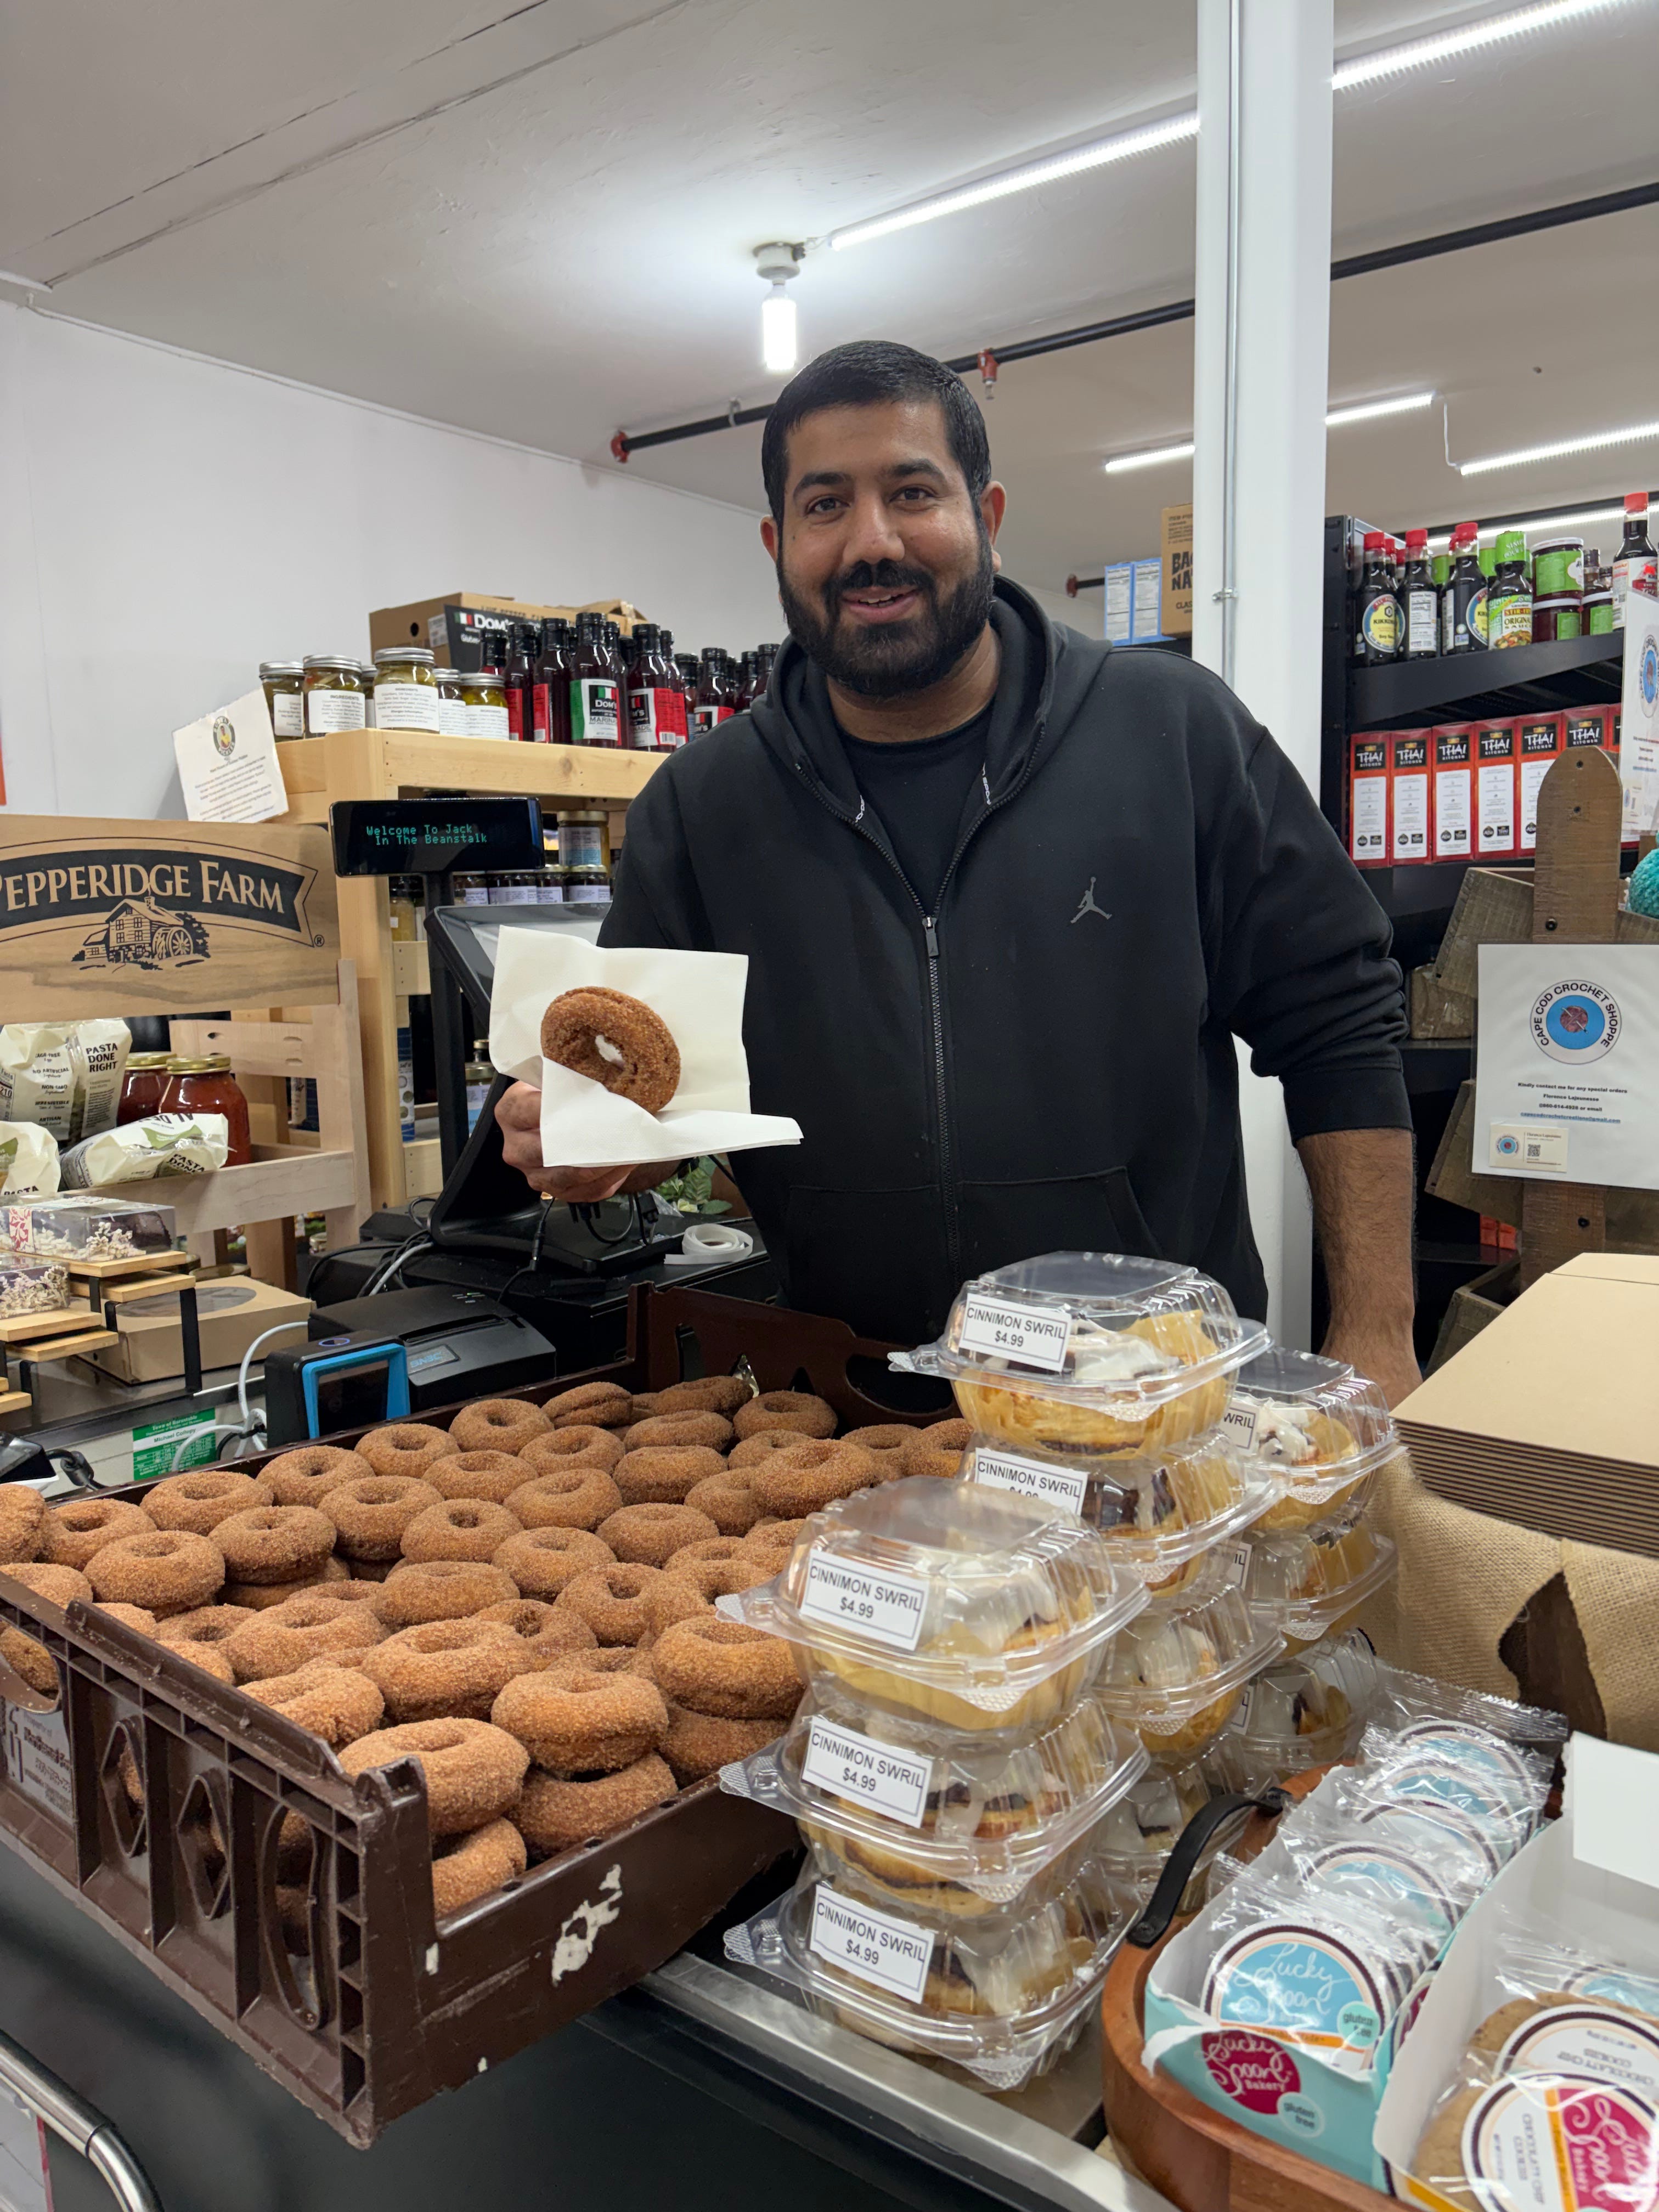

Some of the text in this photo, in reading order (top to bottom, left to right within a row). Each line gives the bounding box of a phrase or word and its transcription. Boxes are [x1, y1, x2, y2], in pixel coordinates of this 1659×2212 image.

[1172, 551, 1193, 575] BA
[1172, 569, 1193, 591] NA
[1525, 733, 1554, 747] THAI
[1569, 727, 1600, 741] THAI
[1438, 744, 1466, 755] THAI
[1481, 738, 1510, 751] THAI
[1357, 752, 1383, 763] THAI
[1397, 749, 1424, 761] THAI
[366, 823, 472, 836] Welcome To Jack
[375, 833, 487, 845] In The Beanstalk
[0, 860, 284, 913] EPPERIDGE FARM
[1534, 983, 1618, 1048] CAPE COD CROCHET SHOPPE
[86, 1043, 118, 1054] PASTA
[88, 1052, 115, 1063] DONE
[89, 1061, 117, 1073] RIGHT
[174, 1154, 205, 1172] PASTA
[967, 1307, 1065, 1340] CINNIMON SWRIL
[995, 1330, 1024, 1347] $4.99
[1223, 1413, 1254, 1429] WRIL
[154, 1433, 175, 1443] Michael
[978, 1462, 1036, 1486] CINNIMON
[1039, 1477, 1080, 1498] SWRIL
[809, 1565, 921, 1613] CINNIMON SWRIL
[839, 1596, 874, 1618] $4.99
[811, 1733, 923, 1789] CINNIMON SWRIL
[843, 1767, 877, 1792] $4.99
[816, 1902, 926, 1963] CINNIMON SWRIL
[845, 1939, 879, 1965] $4.99
[1234, 1943, 1353, 2002] Lucky
[1353, 2024, 1372, 2038] fee
[1196, 2030, 1287, 2072] Lucky
[1207, 2063, 1290, 2097] Spoon
[1244, 2078, 1285, 2092] Bakery
[1284, 2102, 1315, 2118] gluten
[1295, 2115, 1315, 2129] free
